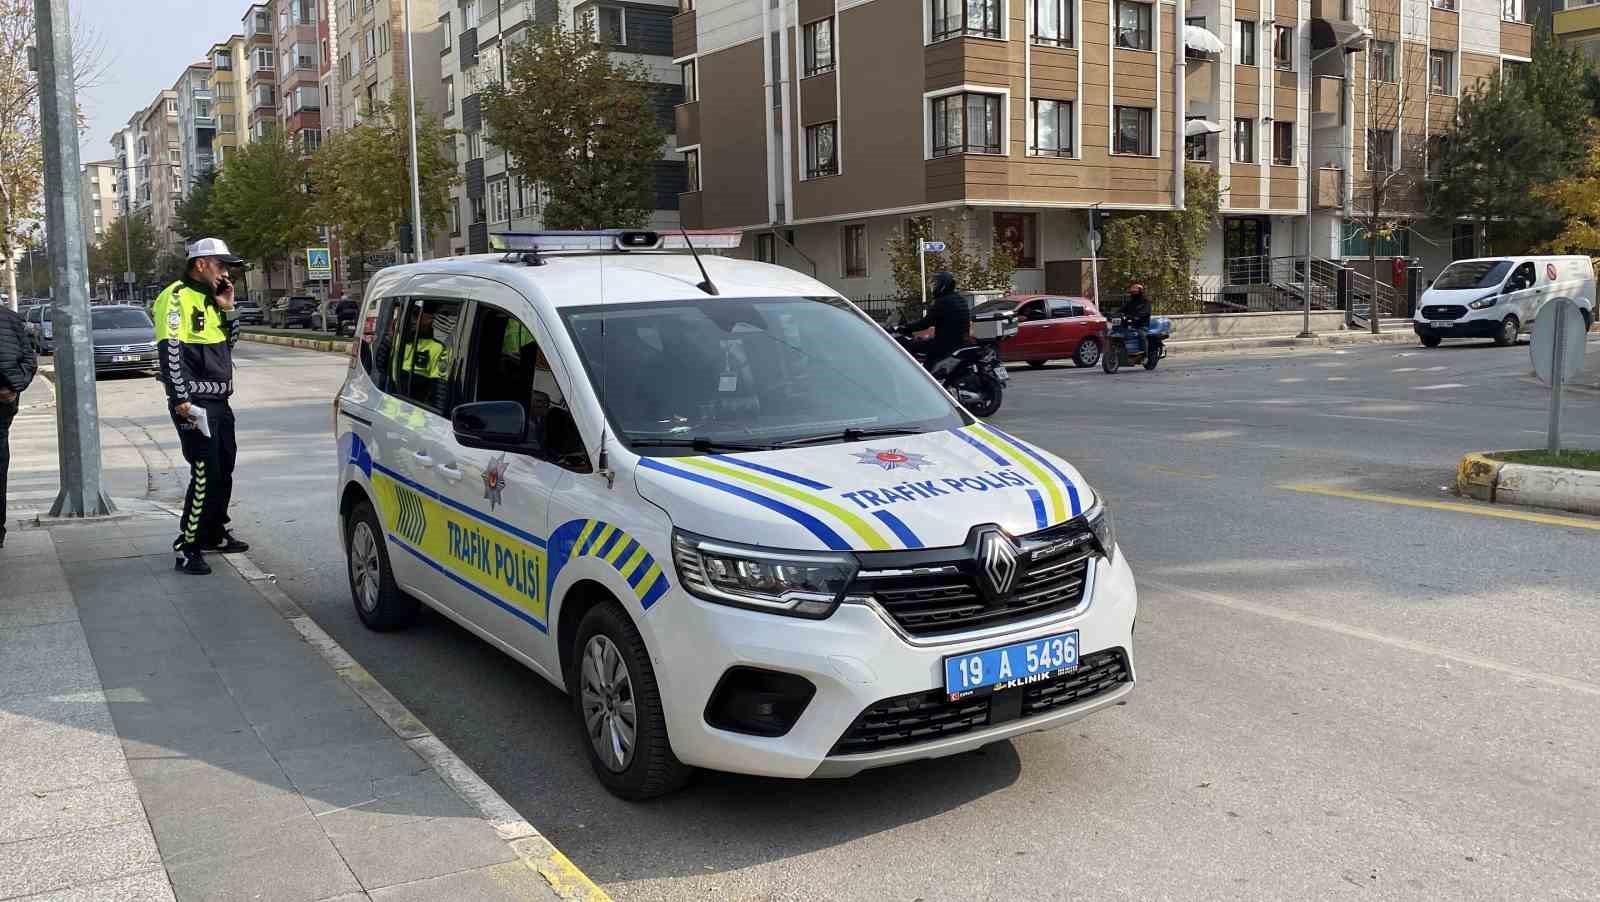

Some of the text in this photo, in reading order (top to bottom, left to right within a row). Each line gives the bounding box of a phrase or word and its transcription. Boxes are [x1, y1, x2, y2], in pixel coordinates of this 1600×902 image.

[840, 469, 1034, 509] TRAFİK POLİSİ
[447, 521, 540, 602] TRAFİK POLİSİ
[959, 636, 1076, 687] 19 A 5436
[1007, 671, 1051, 689] KLINIK
